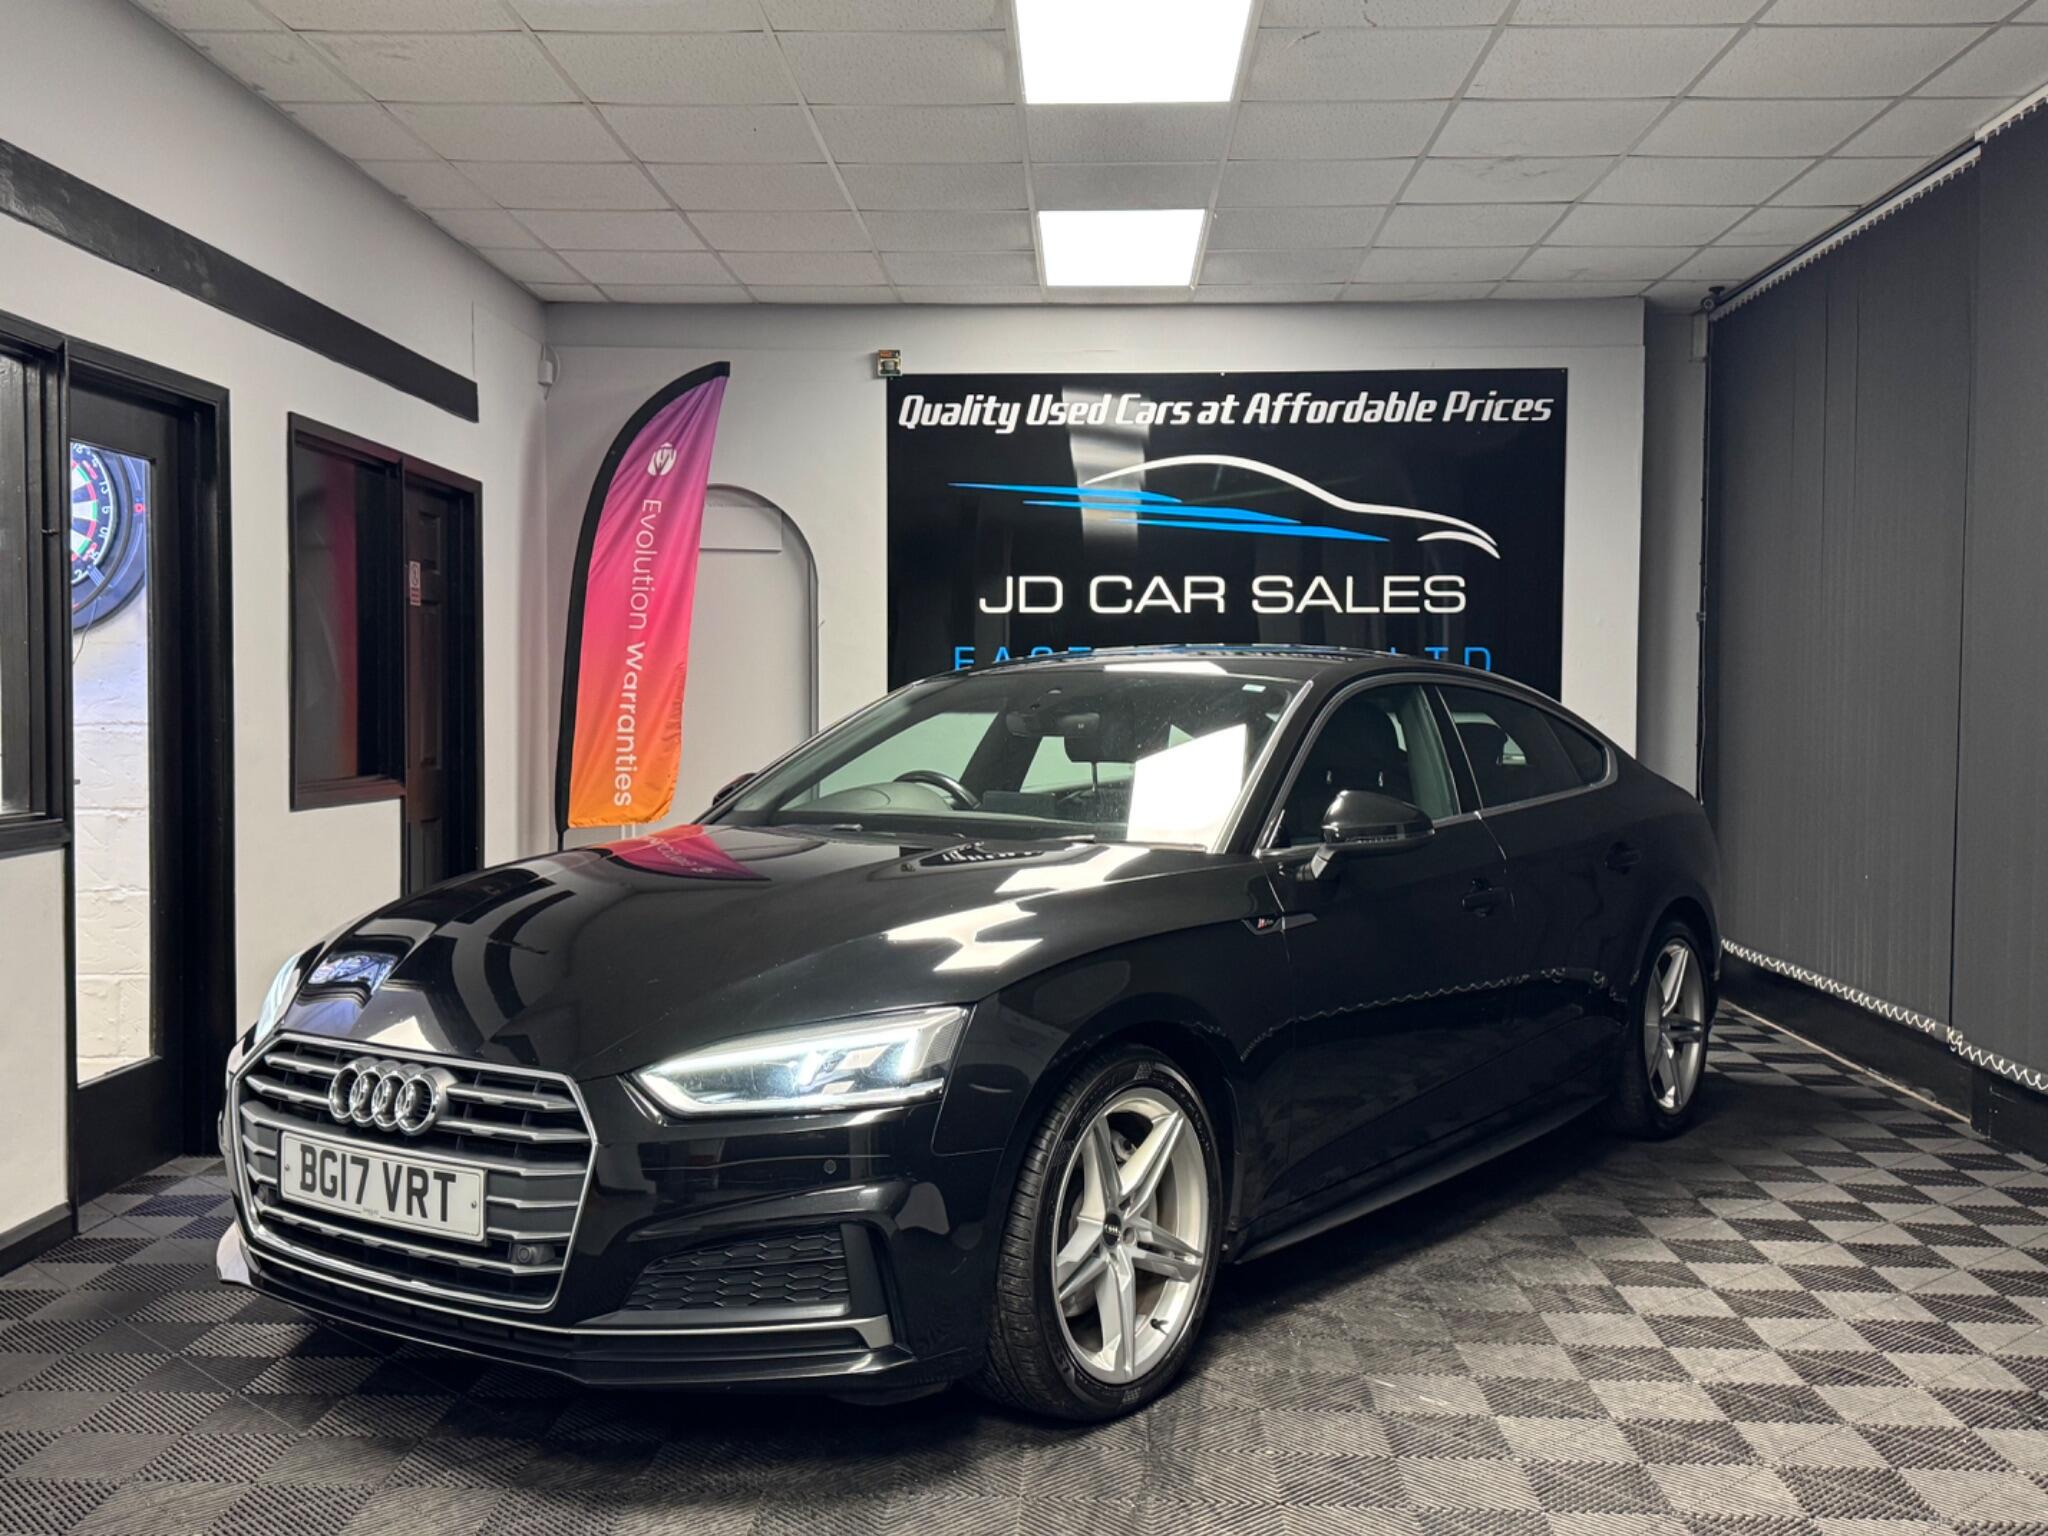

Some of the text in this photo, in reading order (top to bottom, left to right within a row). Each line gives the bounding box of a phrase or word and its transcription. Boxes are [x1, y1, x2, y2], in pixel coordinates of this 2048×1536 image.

[898, 390, 1554, 434] Quality Used Cars at Affordable Prices
[977, 574, 1468, 615] JD CAR SALES
[613, 498, 662, 807] Evolution warranties
[299, 1143, 457, 1223] BG17 VRT
